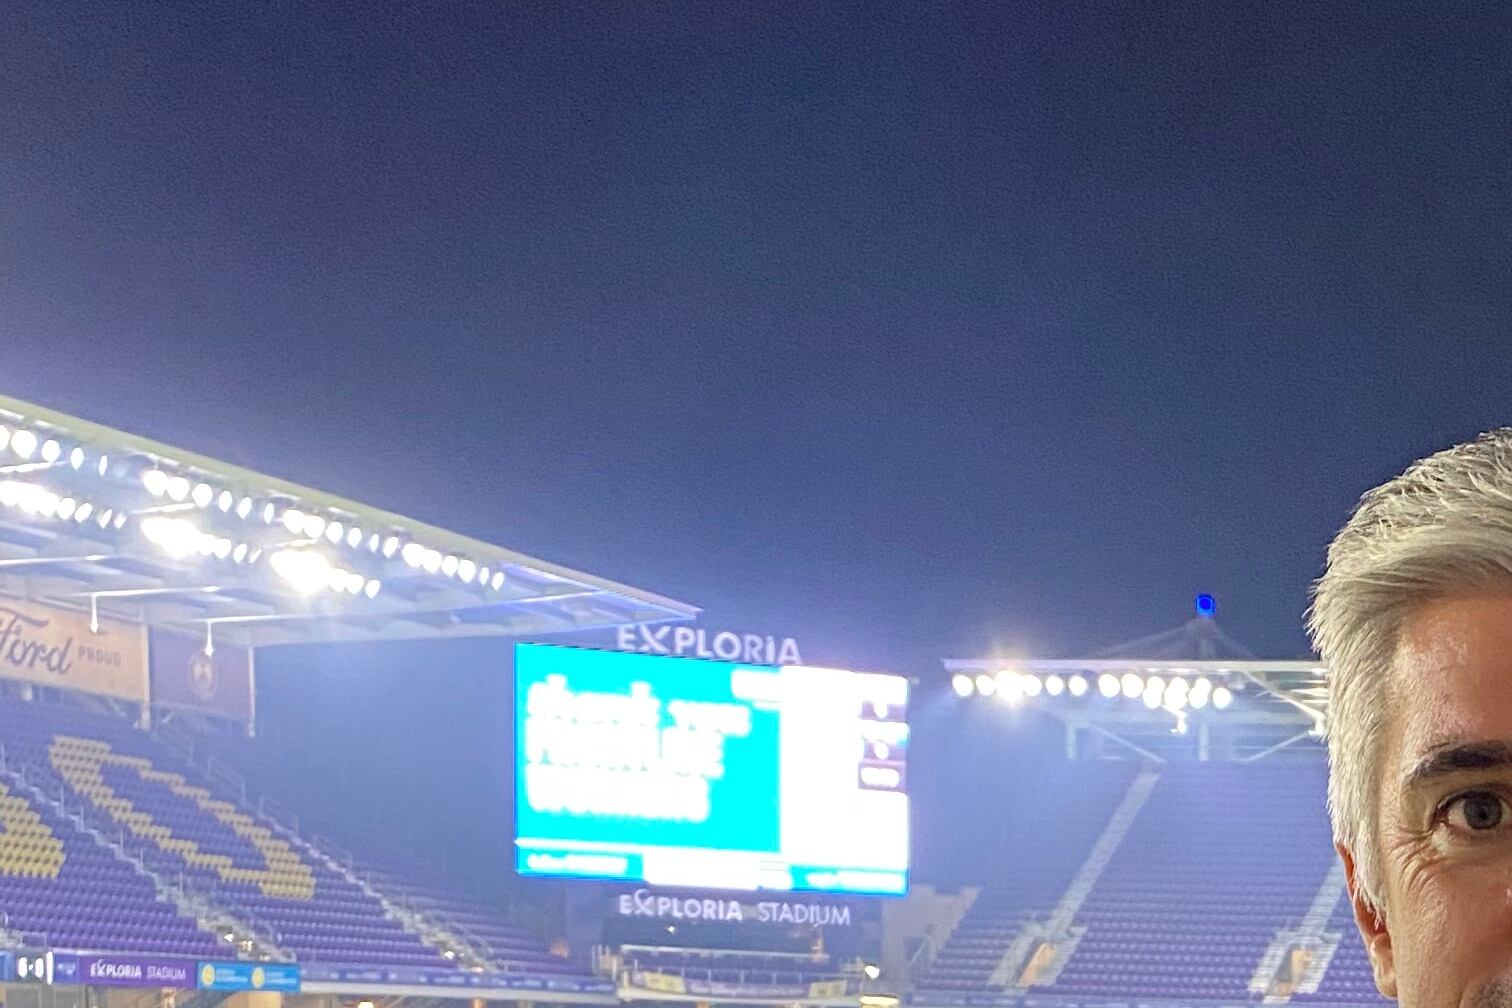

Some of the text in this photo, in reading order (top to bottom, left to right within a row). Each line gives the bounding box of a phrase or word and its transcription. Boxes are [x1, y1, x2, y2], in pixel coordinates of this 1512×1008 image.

[79, 645, 122, 667] PROUD
[617, 624, 802, 666] EXPLORIA
[618, 888, 851, 927] EXPLORIA STADIUM
[90, 959, 142, 979] EXPLORIA
[146, 966, 186, 981] STADIUM
